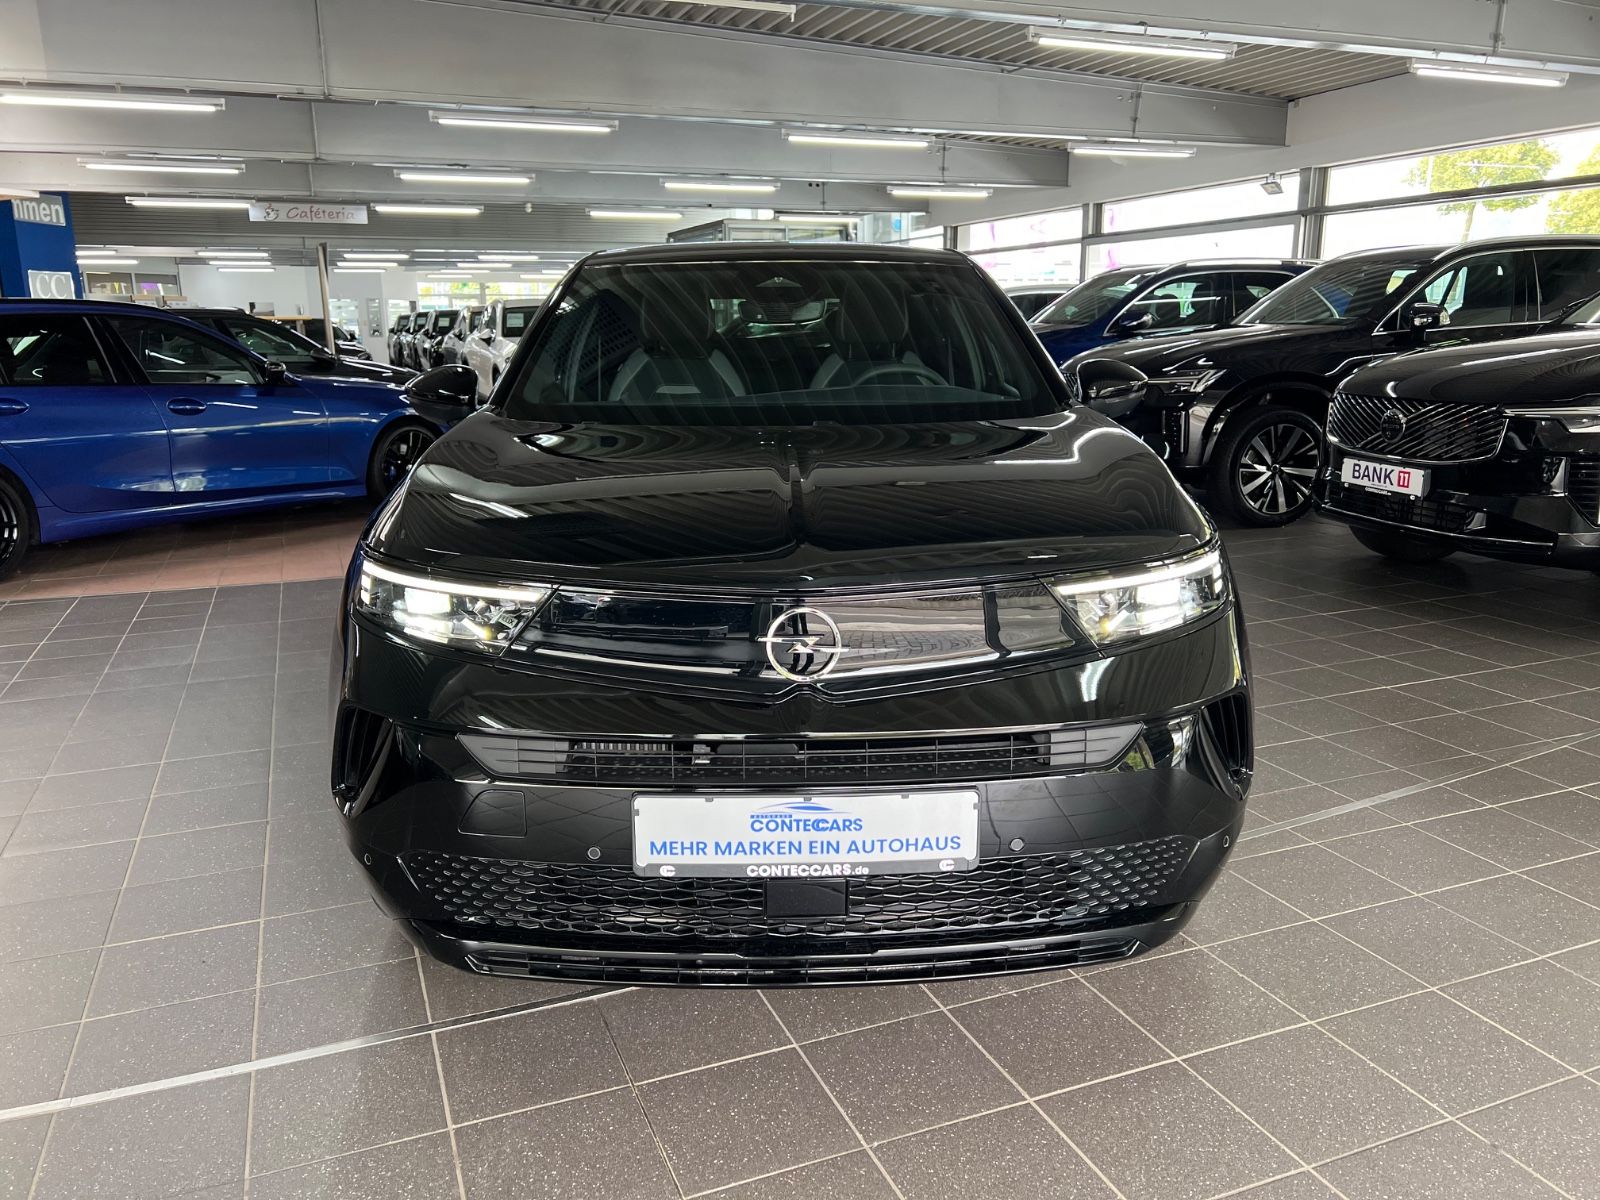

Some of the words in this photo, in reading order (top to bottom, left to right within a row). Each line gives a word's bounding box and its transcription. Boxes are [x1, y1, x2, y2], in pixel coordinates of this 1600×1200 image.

[1352, 463, 1395, 486] BANK
[1399, 472, 1410, 487] 11
[649, 841, 707, 856] MEHR
[714, 840, 802, 856] MARKEN
[808, 840, 840, 855] EIN
[846, 836, 961, 854] AUTOHAUS
[746, 863, 870, 877] CONTECCARS.de
